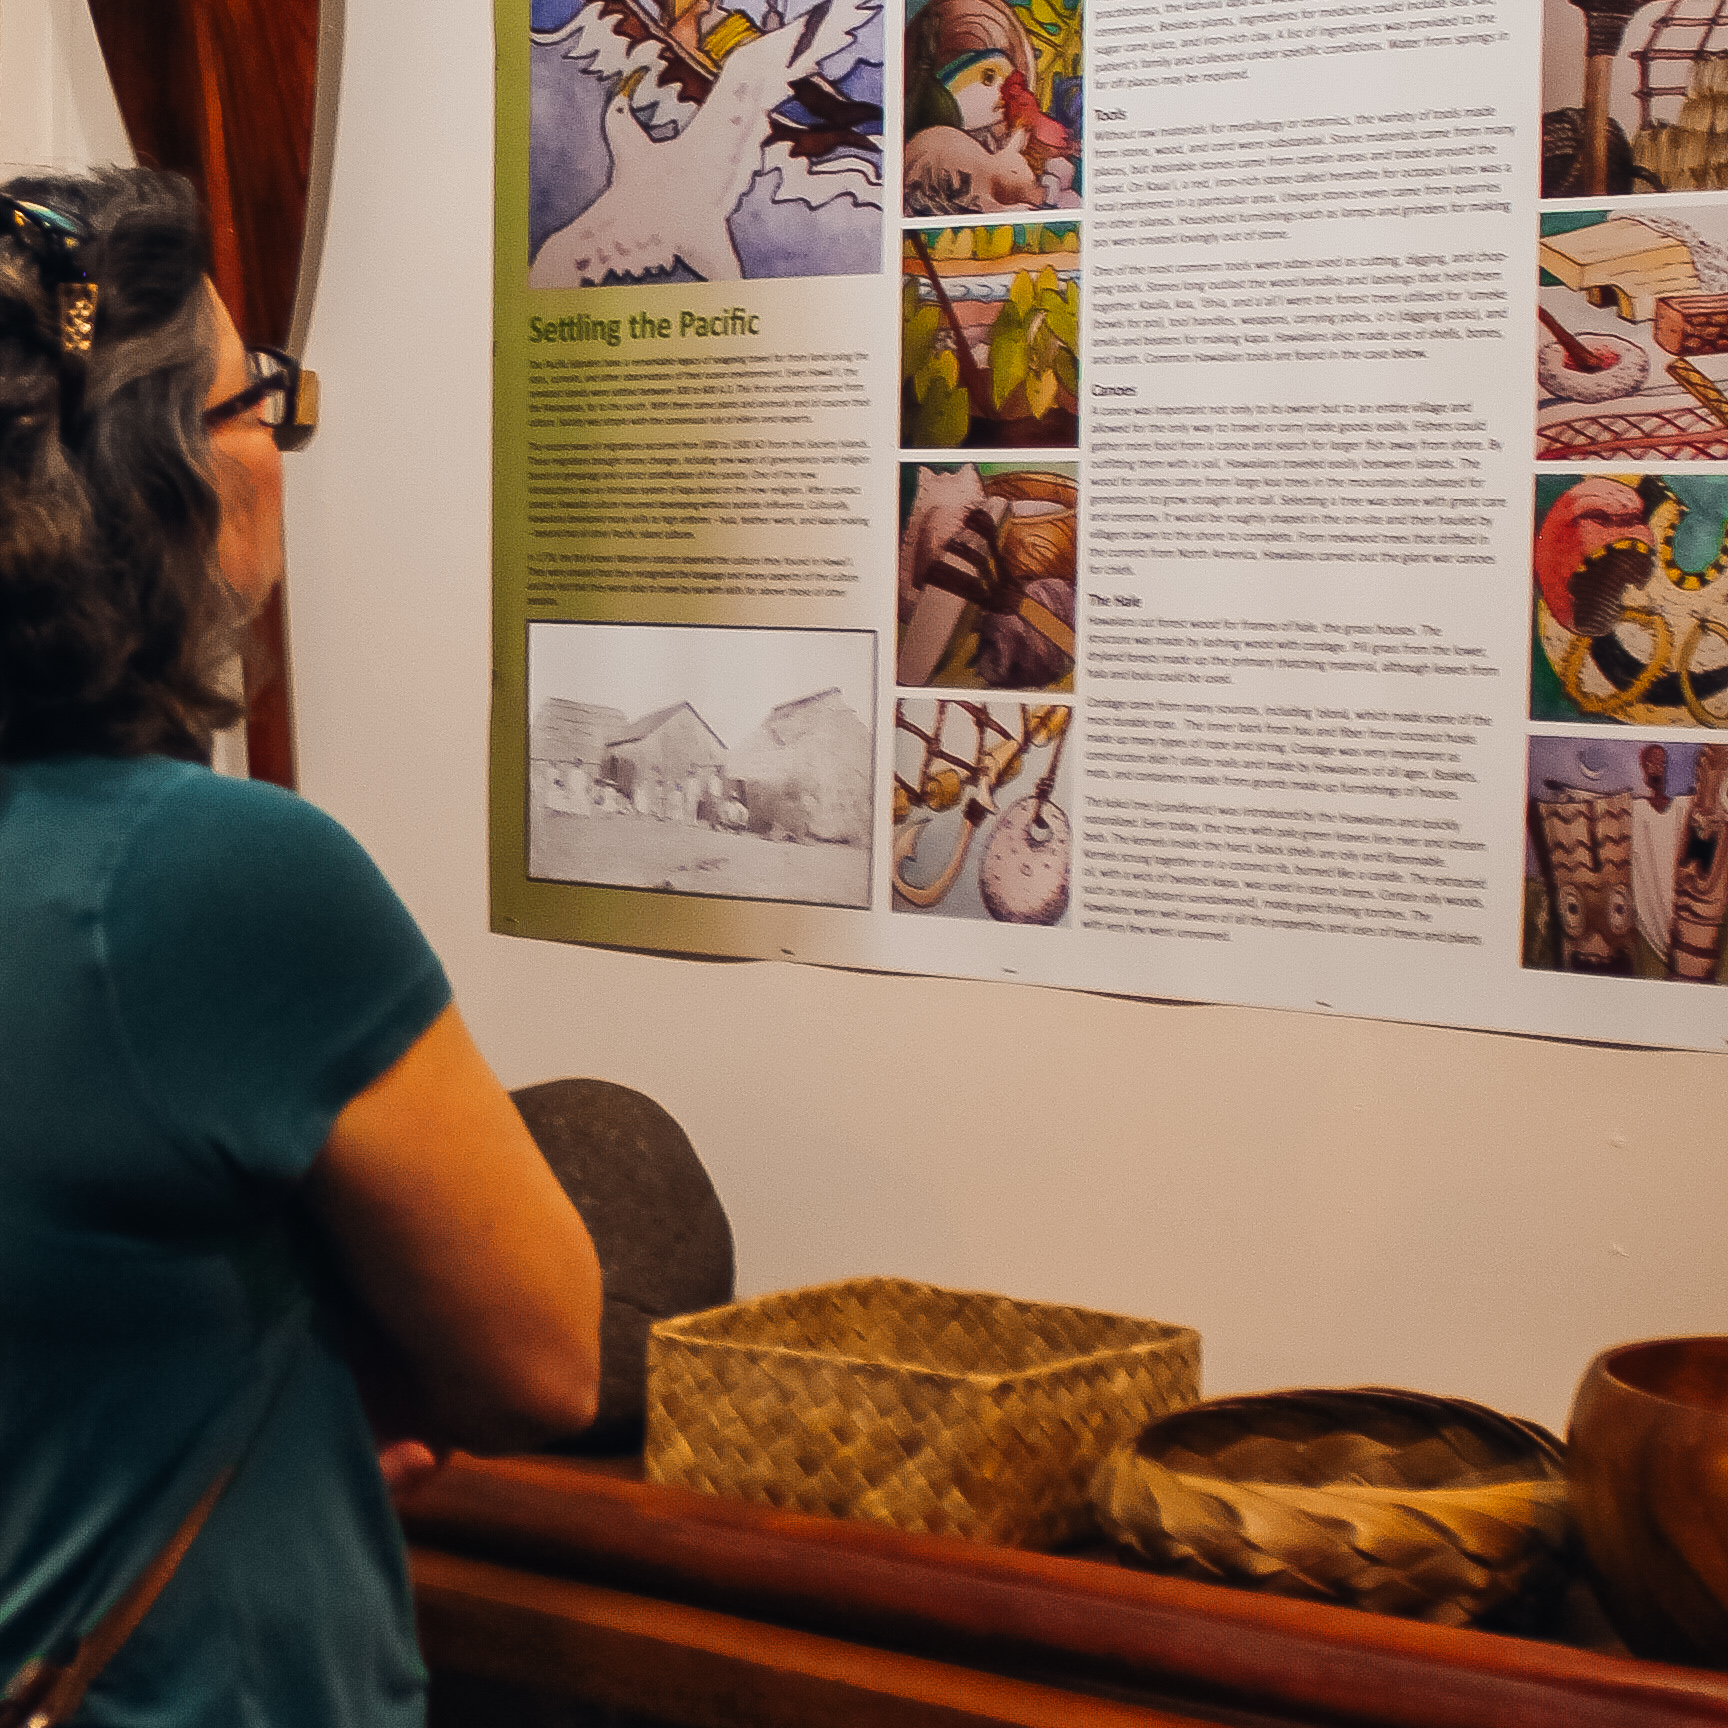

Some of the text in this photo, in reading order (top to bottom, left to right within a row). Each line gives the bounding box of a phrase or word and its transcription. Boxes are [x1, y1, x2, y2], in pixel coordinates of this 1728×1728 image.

[1095, 110, 1126, 121] Tools
[530, 308, 760, 346] Settling the Pacific
[1091, 383, 1137, 397] Canoes
[1088, 594, 1111, 607] The
